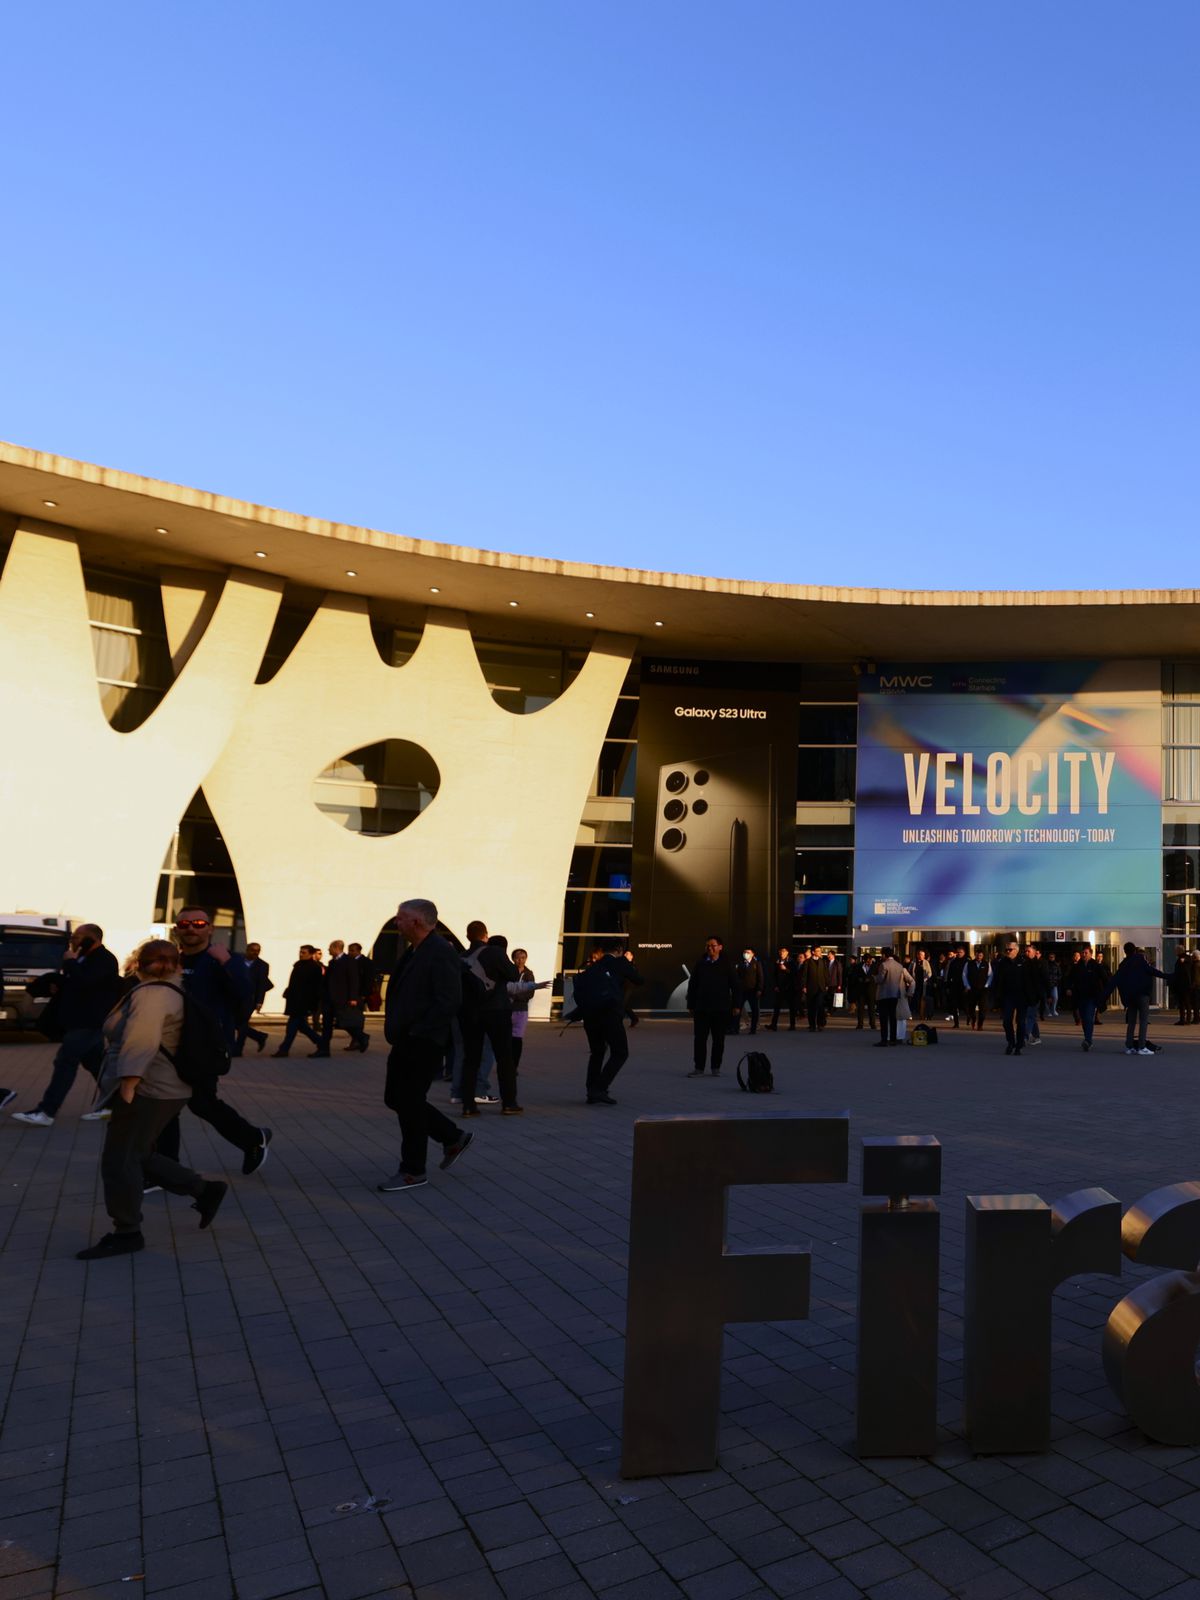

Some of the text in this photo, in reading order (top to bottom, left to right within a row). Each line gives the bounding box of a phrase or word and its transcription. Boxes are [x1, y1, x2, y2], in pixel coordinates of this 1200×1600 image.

[649, 664, 700, 676] SAMSUNG
[879, 675, 933, 688] MWC
[674, 706, 767, 720] Galaxy S23 Ultra
[904, 751, 1116, 816] VELOCITY
[903, 829, 958, 844] UNLEASHING
